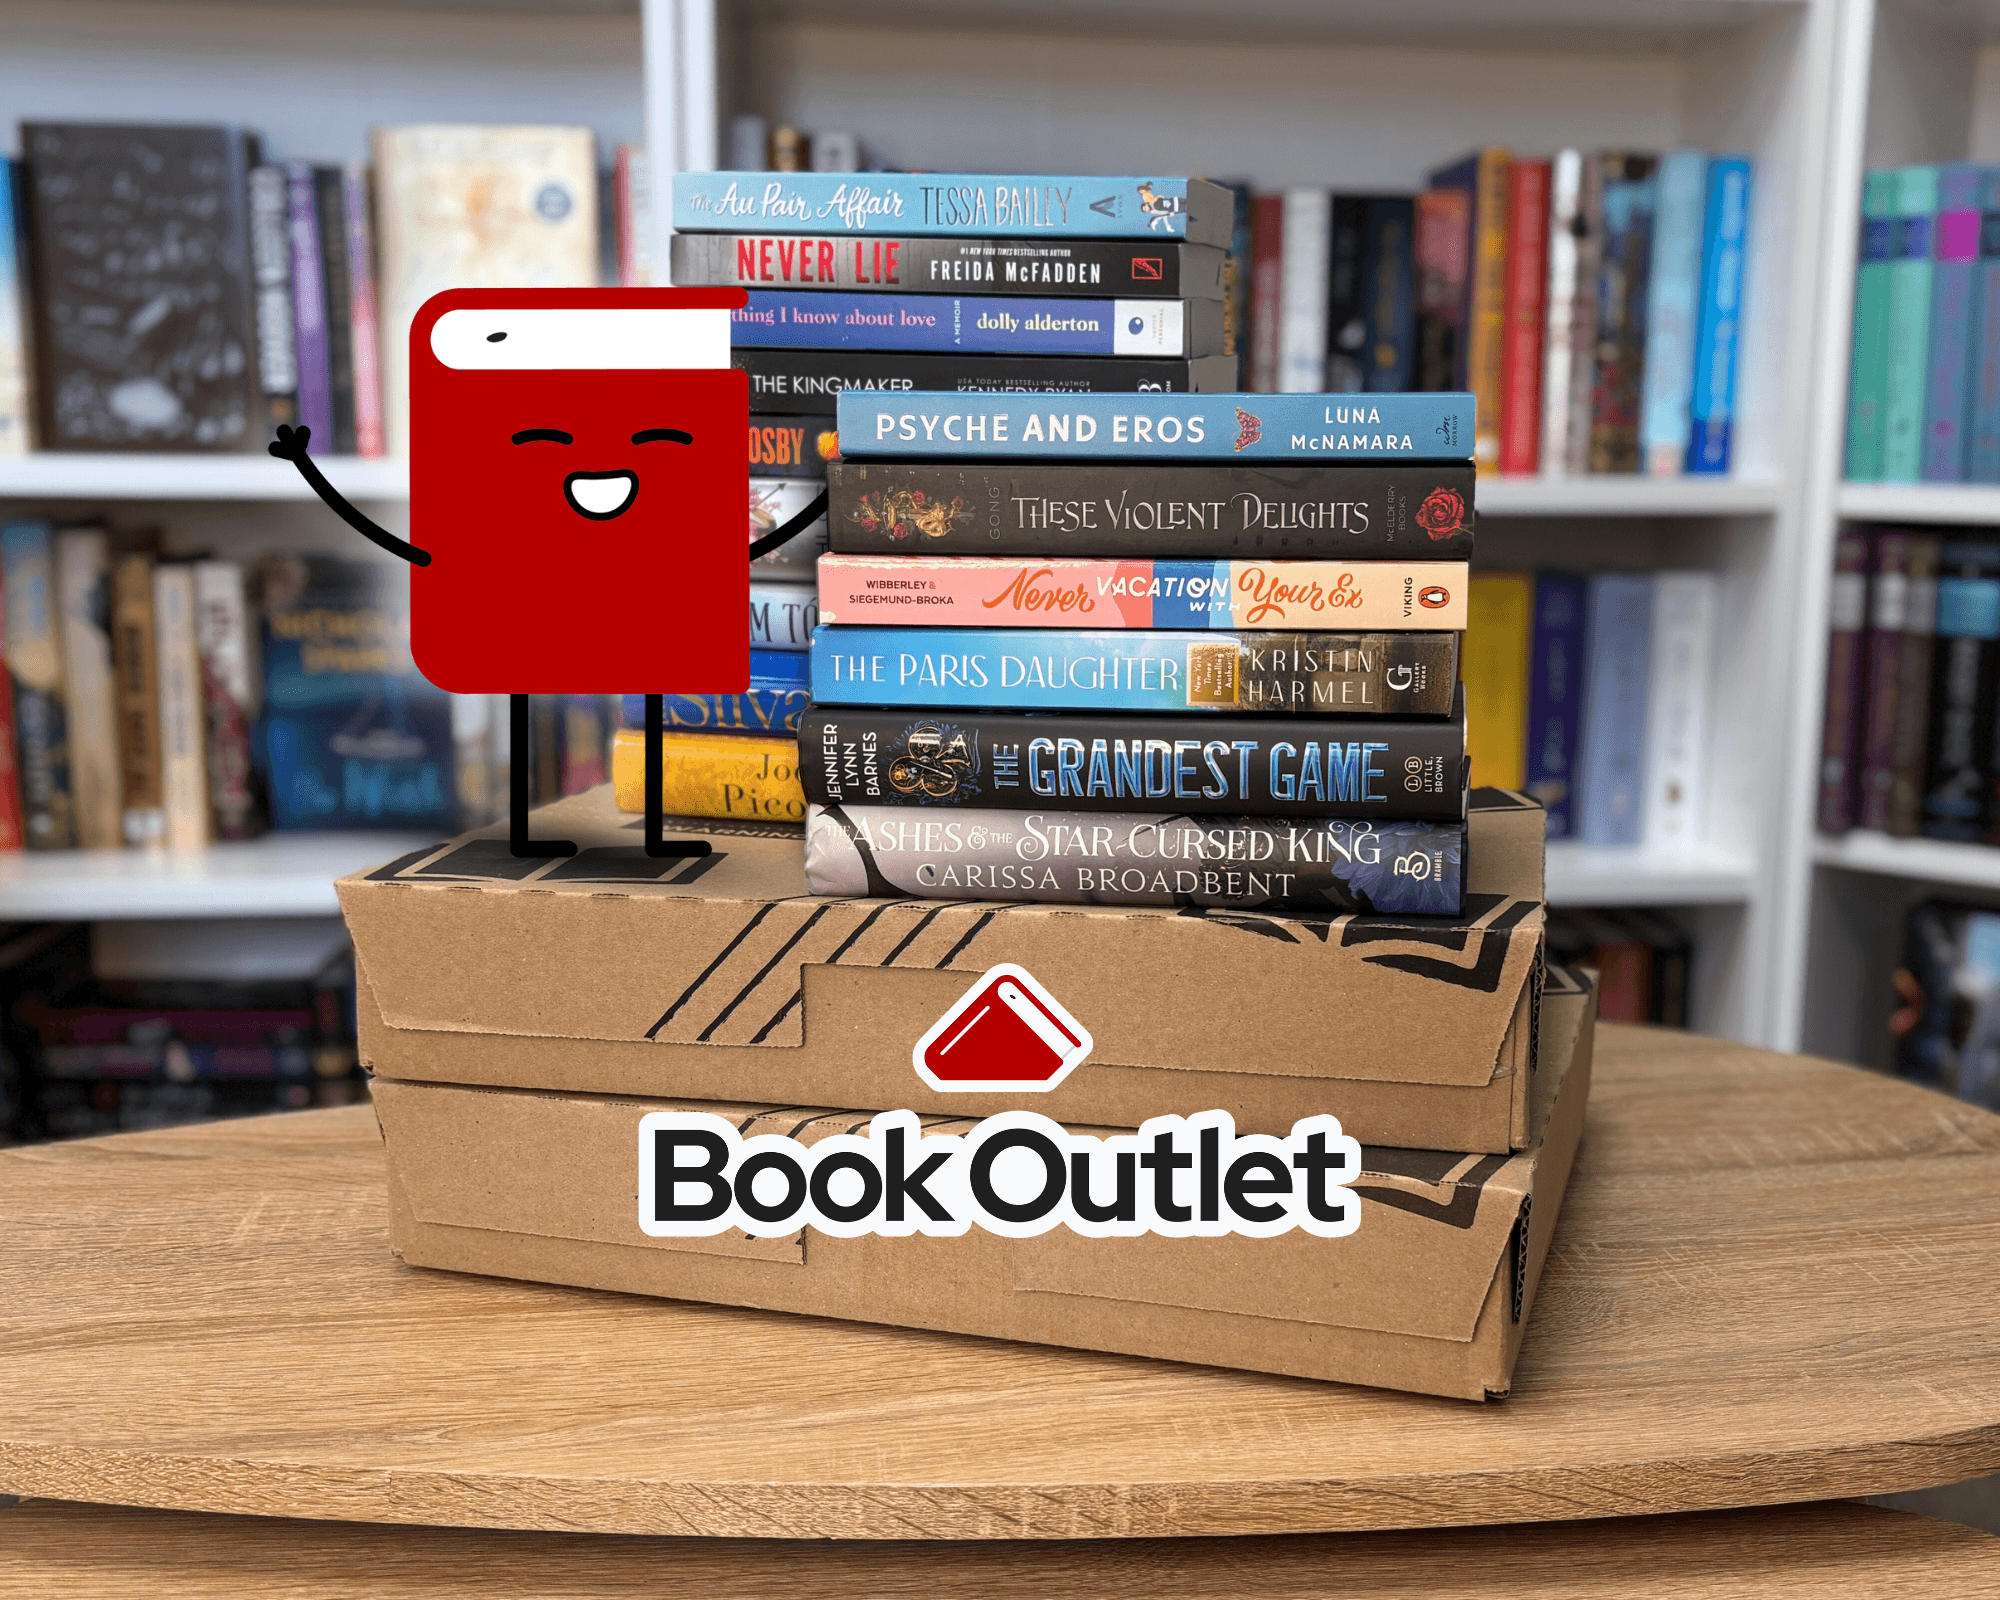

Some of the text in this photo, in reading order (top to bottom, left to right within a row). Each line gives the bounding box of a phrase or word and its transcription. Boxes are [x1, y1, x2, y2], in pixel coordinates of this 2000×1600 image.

[690, 181, 904, 230] The Au Pair Affair
[920, 186, 1072, 227] TESSA BAILEY
[738, 239, 900, 285] NEVER LIE
[969, 247, 982, 257] NEW
[982, 247, 996, 257] YORK
[997, 247, 1013, 257] TIMES
[1013, 247, 1049, 258] BESTSELLING
[1049, 248, 1072, 258] AUTHOR
[930, 260, 1101, 284] FREIDA McFADDEN
[780, 307, 788, 324] I
[793, 308, 840, 325] know
[845, 309, 894, 326] about
[900, 309, 937, 327] love
[976, 312, 1100, 333] dolly alderton
[954, 337, 961, 345] A
[752, 375, 913, 395] THE KINGMAKER
[976, 378, 1001, 386] TODAY
[1005, 379, 1055, 387] BESTSELLING
[876, 413, 1206, 443] PSYCHE AND EROS
[1291, 406, 1414, 450] LUNA McNAMARA
[989, 486, 1000, 540] GONG
[1010, 489, 1369, 534] THESE VIOLENT DELIGHTS
[1386, 484, 1396, 542] McELDERRY
[1398, 495, 1407, 530] BOOKS
[849, 594, 954, 605] SIEGEMUND-BROKA
[866, 580, 936, 590] WIBBERLEY &
[982, 568, 1095, 613] Never
[1096, 576, 1229, 598] VACATION
[1238, 567, 1363, 624] Your Ex
[1403, 577, 1413, 618] VIKING
[1189, 602, 1241, 612] WITH
[830, 653, 1178, 691] THE PARIS DAUGHTER
[1203, 662, 1212, 685] Times
[1213, 653, 1224, 696] Bestselling
[1224, 659, 1233, 689] Author
[1252, 649, 1372, 673] KRISTIN
[1193, 674, 1202, 693] New
[1249, 680, 1373, 704] HARMEL
[823, 723, 843, 800] JENNIFER
[843, 742, 860, 787] LYNN
[862, 731, 881, 796] BARNES
[994, 743, 1020, 790] THE
[1028, 737, 1389, 803] GRANDEST GAME
[1425, 756, 1435, 793] LITTLE,
[1435, 756, 1444, 793] BROWN
[825, 824, 850, 839] THE
[849, 815, 963, 852] ASHES
[967, 825, 988, 850] &
[990, 832, 1013, 845] THE
[1280, 820, 1382, 864] KING
[916, 863, 1296, 897] CARISSA BROADBENT
[1434, 850, 1443, 882] BRAMBLE
